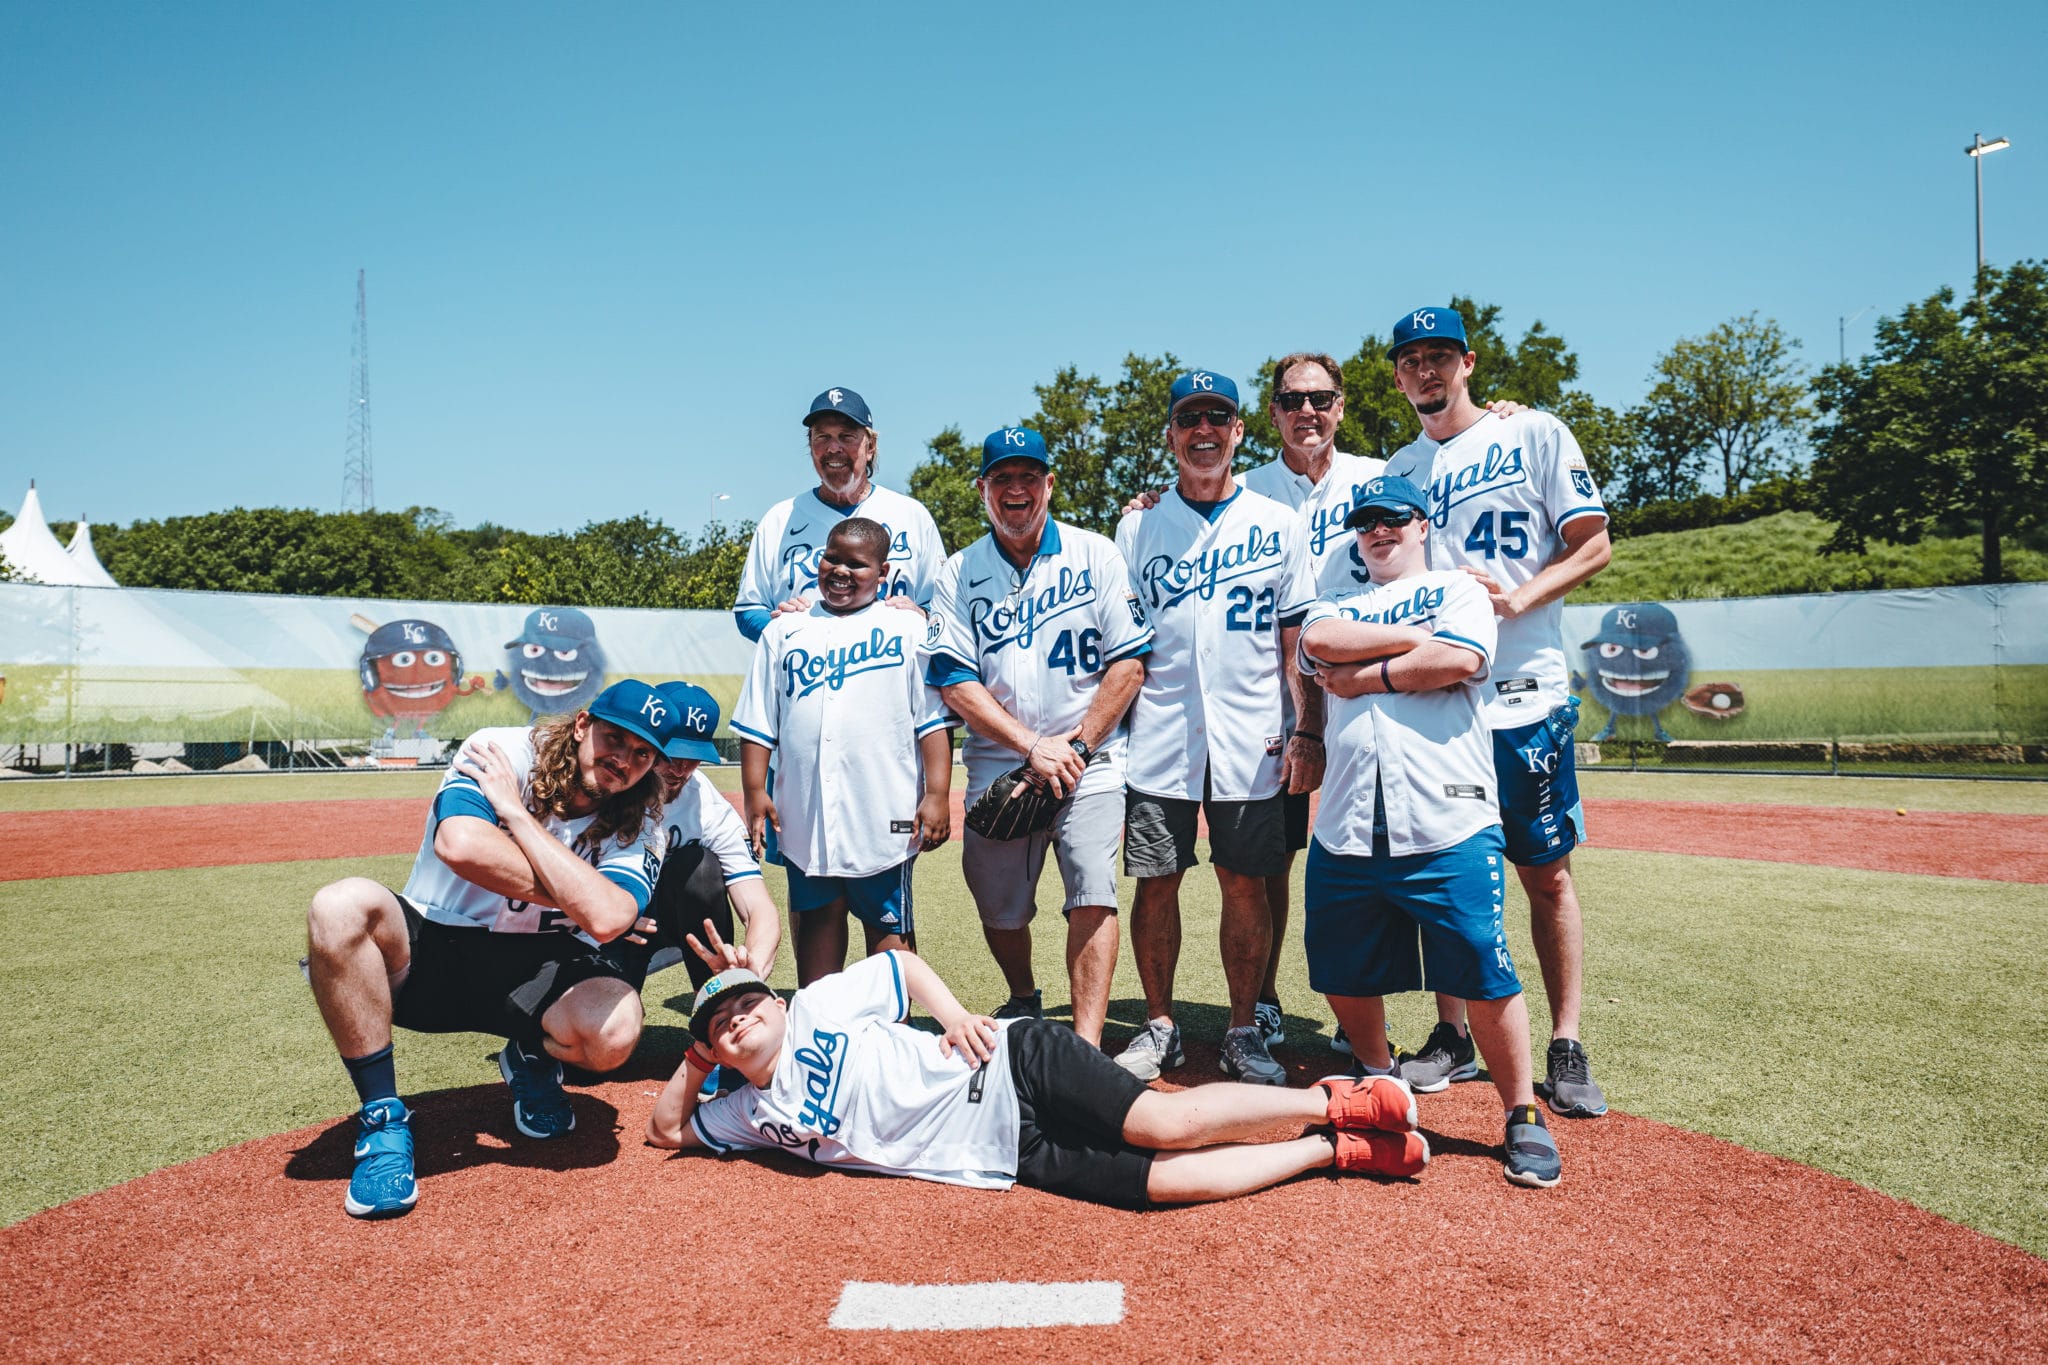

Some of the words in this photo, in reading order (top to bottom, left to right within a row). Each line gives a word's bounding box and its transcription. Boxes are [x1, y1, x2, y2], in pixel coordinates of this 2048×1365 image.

[1413, 310, 1435, 330] KC
[1191, 372, 1213, 391] KC
[1005, 428, 1025, 447] KC
[1365, 480, 1384, 495] KC
[1424, 443, 1526, 529] yals
[1572, 473, 1593, 494] KC
[1465, 511, 1529, 559] 45
[1143, 525, 1282, 614] Royals
[969, 567, 1096, 656] Royals
[1129, 602, 1145, 620] KC
[1227, 586, 1275, 631] 22
[1616, 610, 1637, 629] KC
[402, 623, 426, 644] KC
[538, 612, 559, 632] KC
[783, 628, 904, 701] Royals
[1048, 628, 1102, 675] 46
[640, 695, 666, 727] KC
[686, 706, 707, 732] KC
[1525, 748, 1558, 774] KC
[1539, 778, 1558, 835] ROYALS
[645, 853, 661, 882] KC
[1495, 948, 1512, 972] KC
